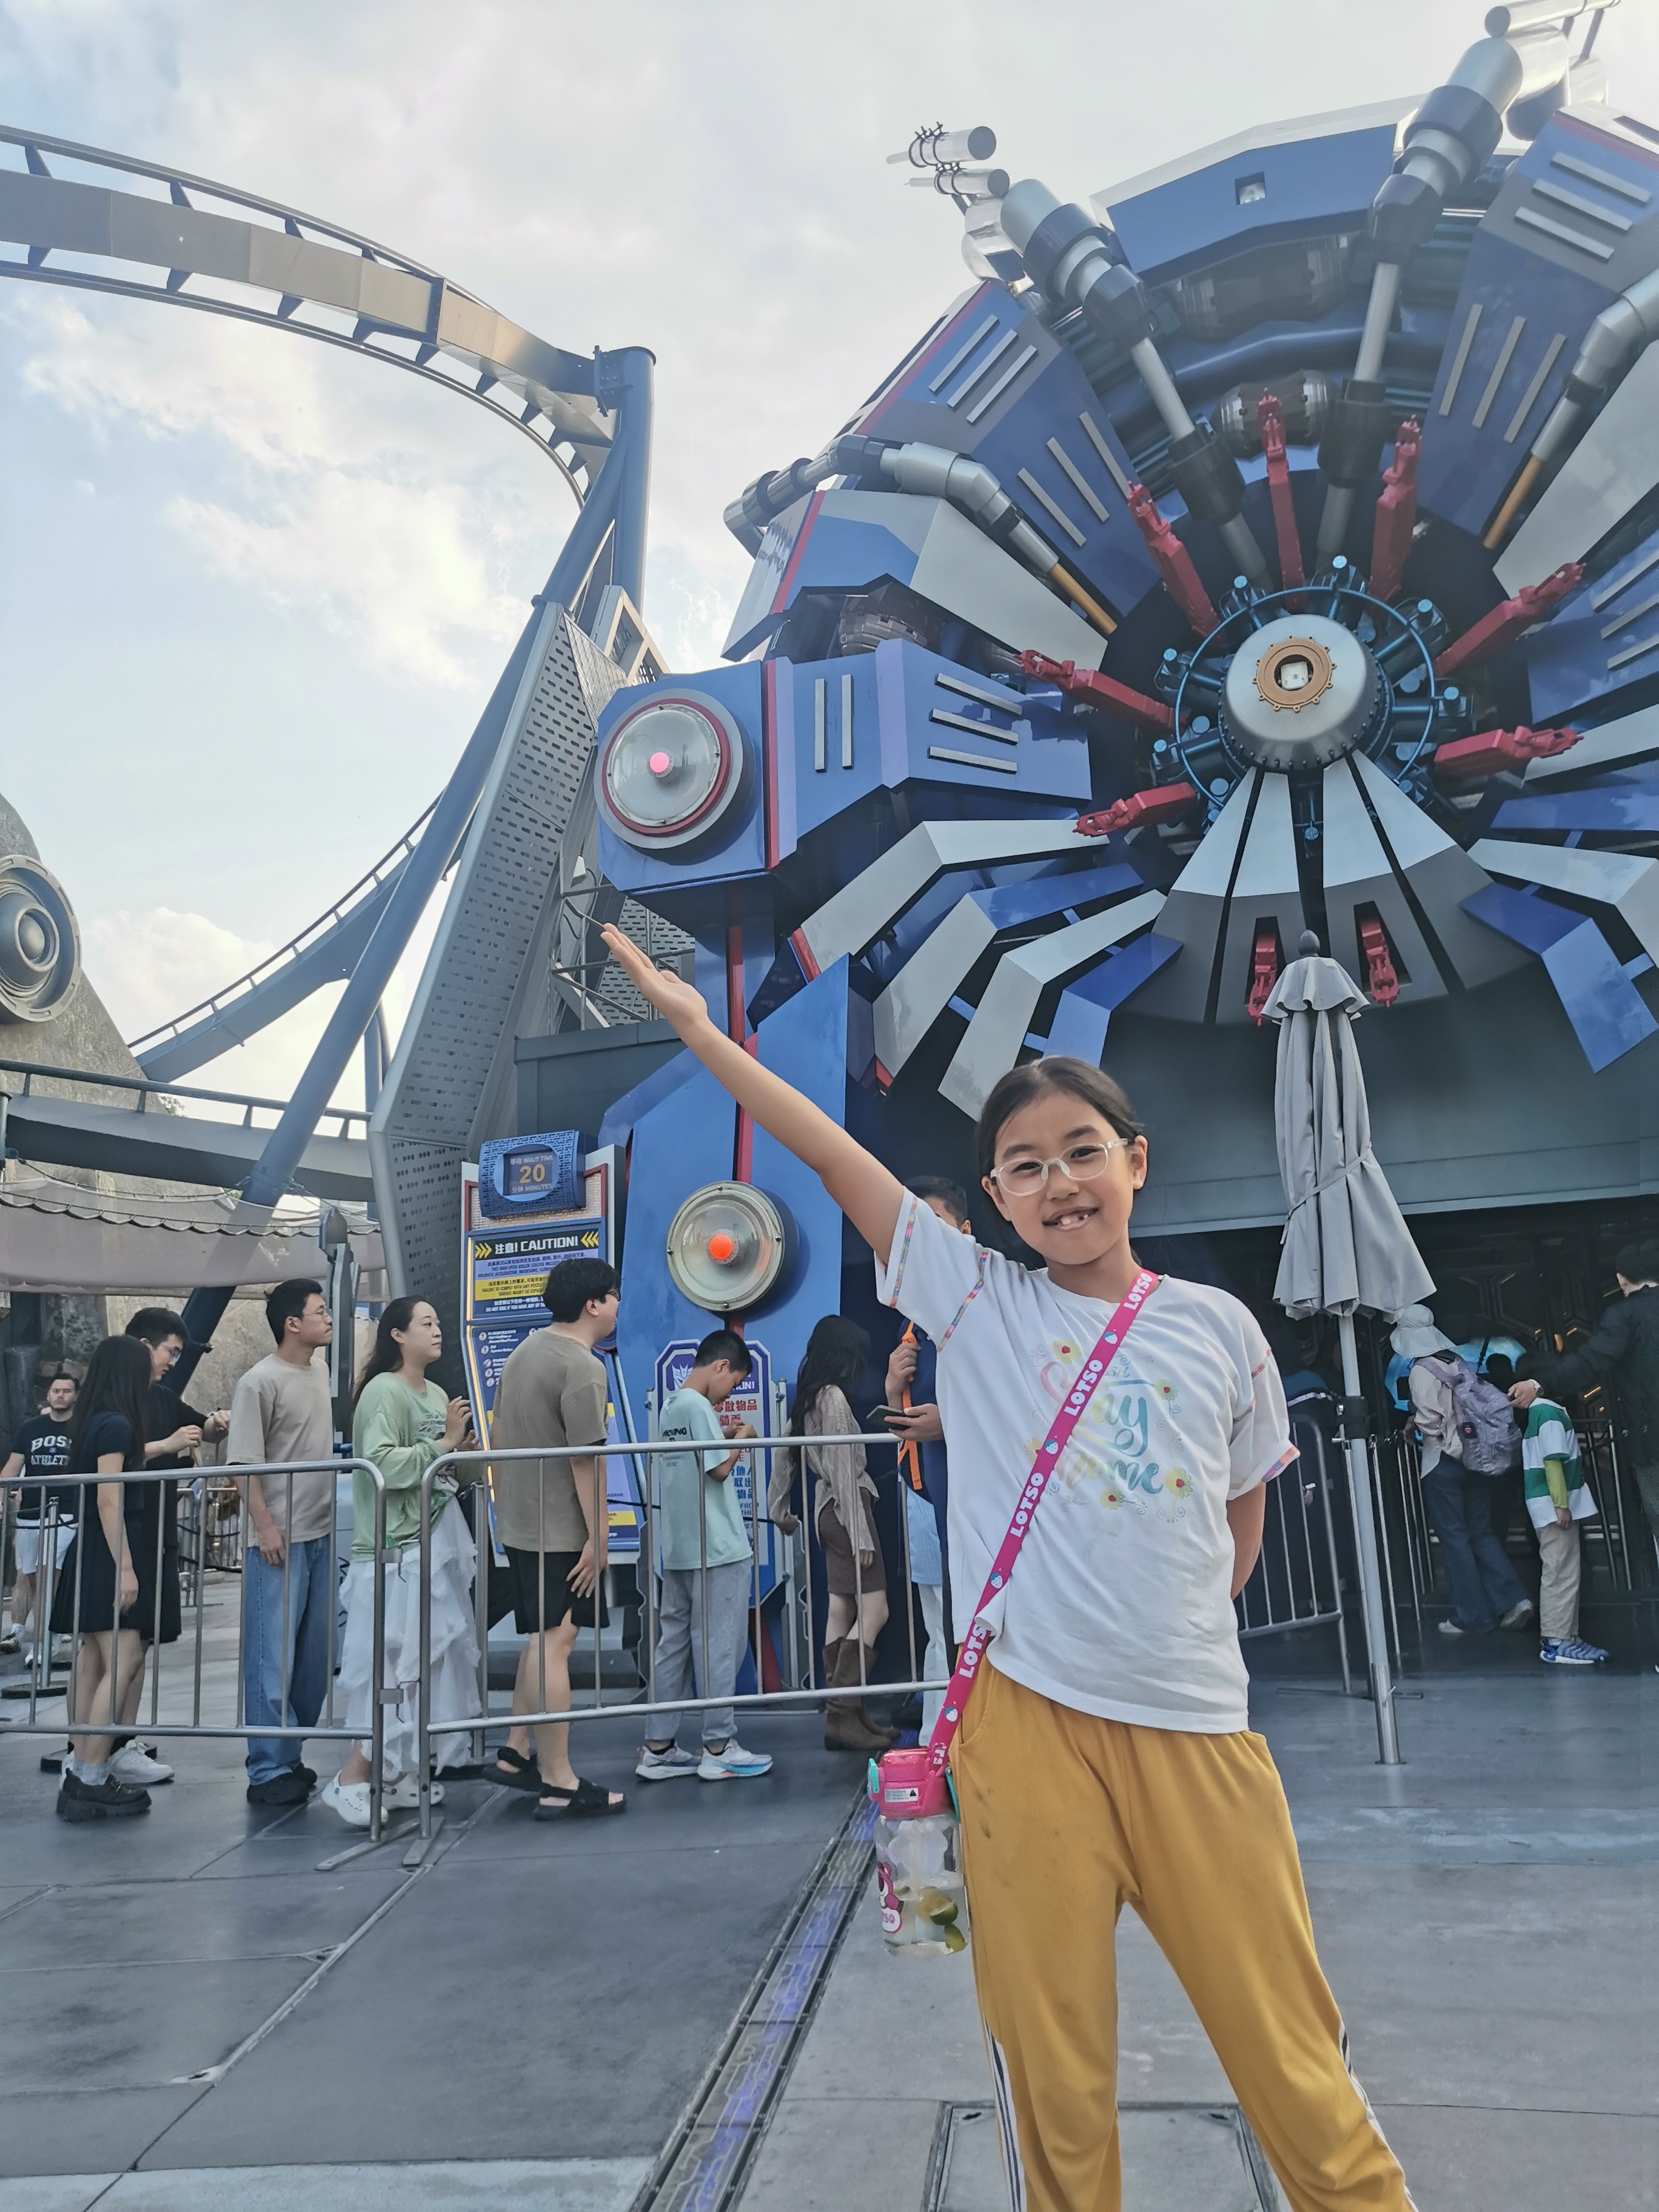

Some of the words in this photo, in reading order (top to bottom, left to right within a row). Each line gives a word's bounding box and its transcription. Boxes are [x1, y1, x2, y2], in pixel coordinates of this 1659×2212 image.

[519, 1164, 545, 1184] 20
[520, 1236, 578, 1252] CAUTION!
[1124, 1272, 1153, 1310] LOTSO
[1064, 1359, 1104, 1416] LOTSO
[1010, 1472, 1044, 1538] LOTSO
[959, 1623, 987, 1679] LOTS
